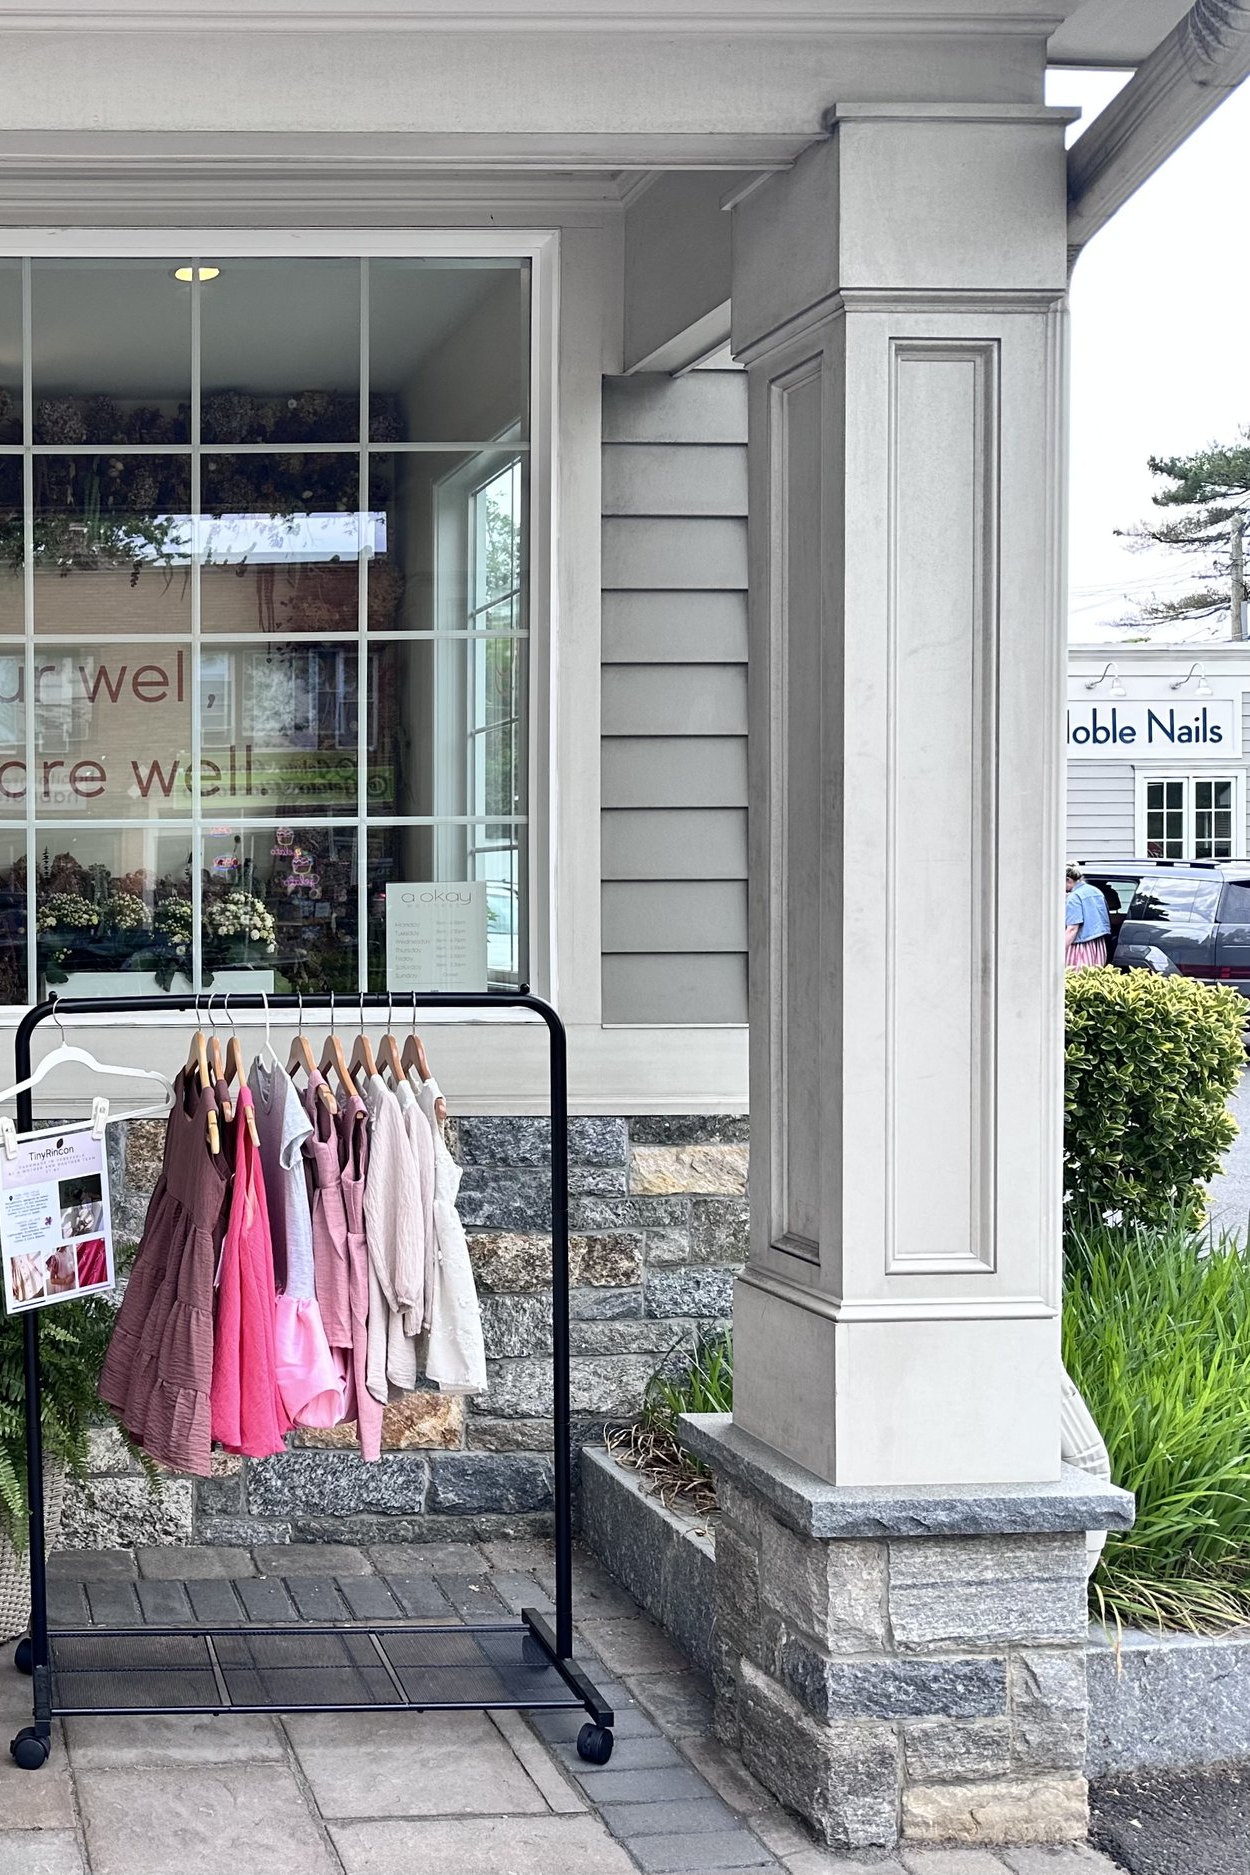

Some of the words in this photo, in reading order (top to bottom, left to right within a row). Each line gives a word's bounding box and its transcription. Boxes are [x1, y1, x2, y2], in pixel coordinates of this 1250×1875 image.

[1067, 707, 1136, 744] oble
[1148, 707, 1223, 743] Nails
[131, 744, 269, 798] well.
[401, 892, 415, 903] a
[420, 889, 472, 906] okay
[395, 972, 418, 980] Sunday
[29, 1146, 74, 1161] TinyRincon
